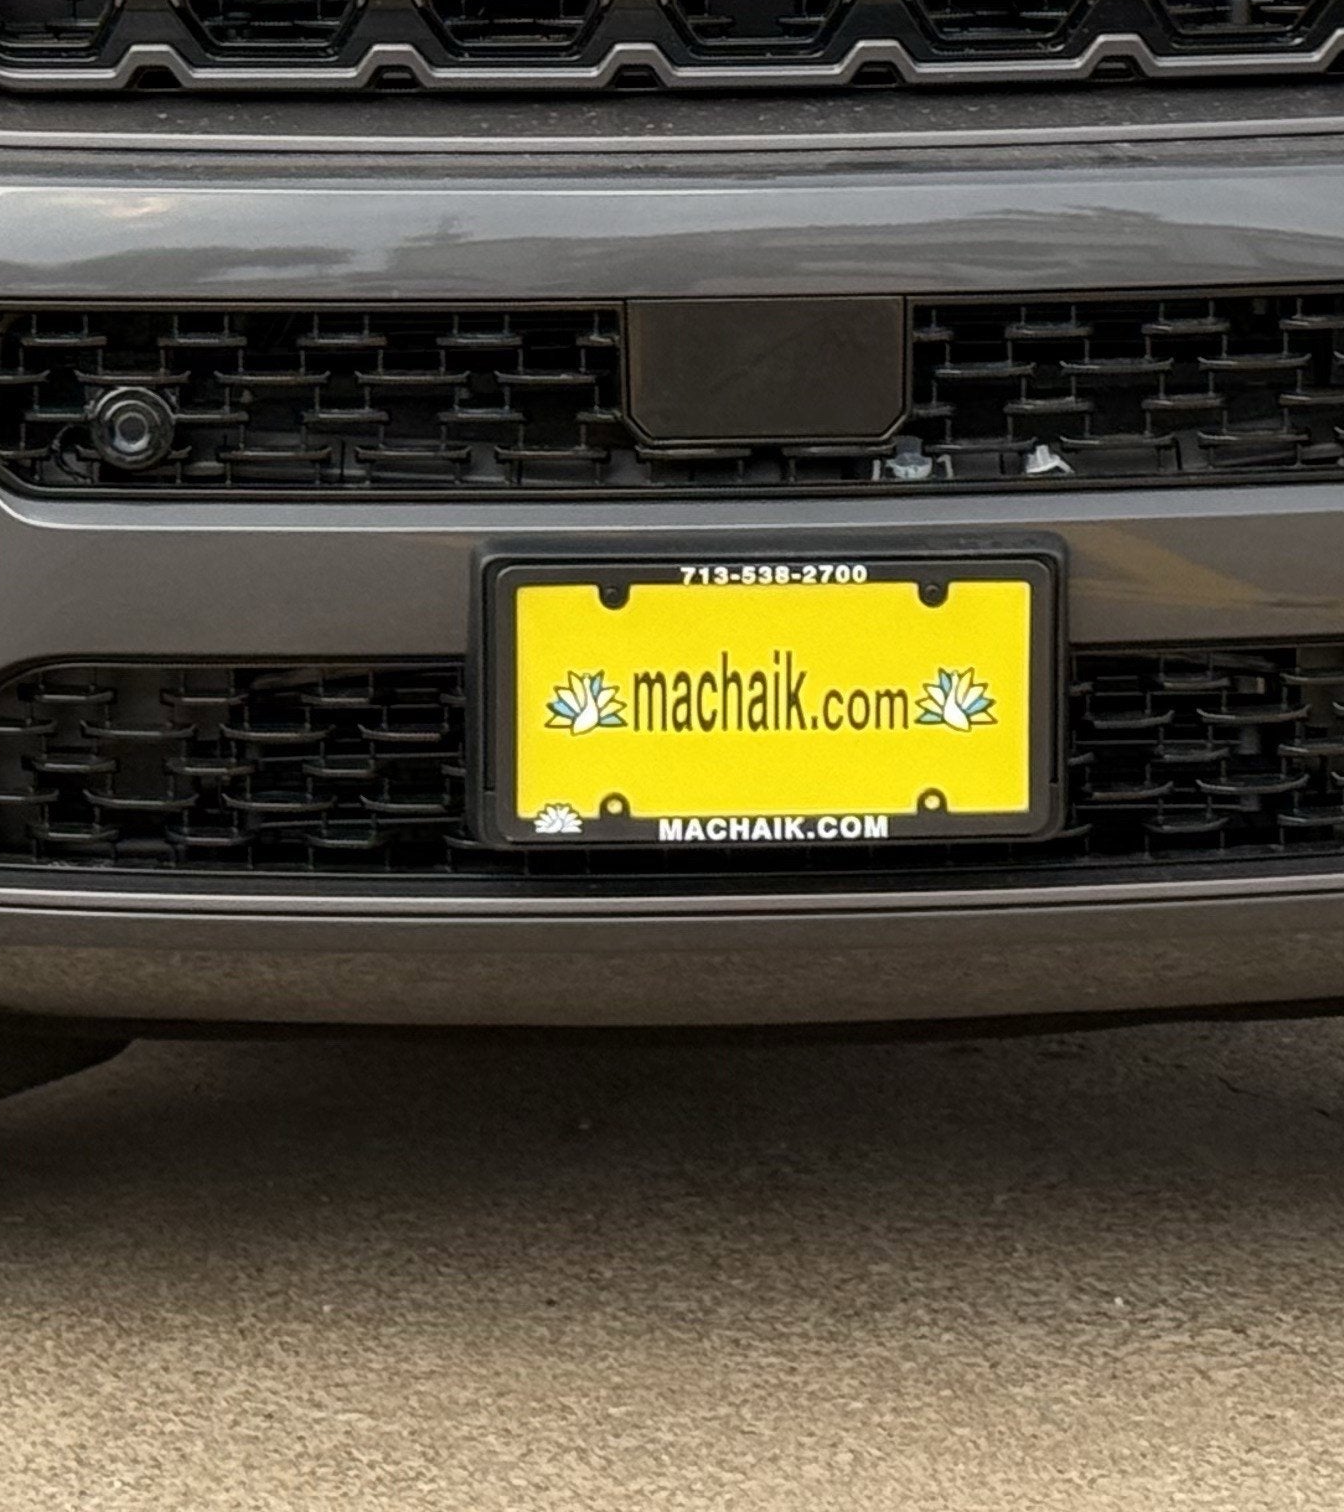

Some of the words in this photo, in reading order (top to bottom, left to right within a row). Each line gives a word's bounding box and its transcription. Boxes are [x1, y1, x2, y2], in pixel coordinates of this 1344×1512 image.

[679, 564, 869, 586] 713-538-2700
[631, 649, 910, 733] machaik.com
[658, 815, 889, 842] MACHAIK.COM
